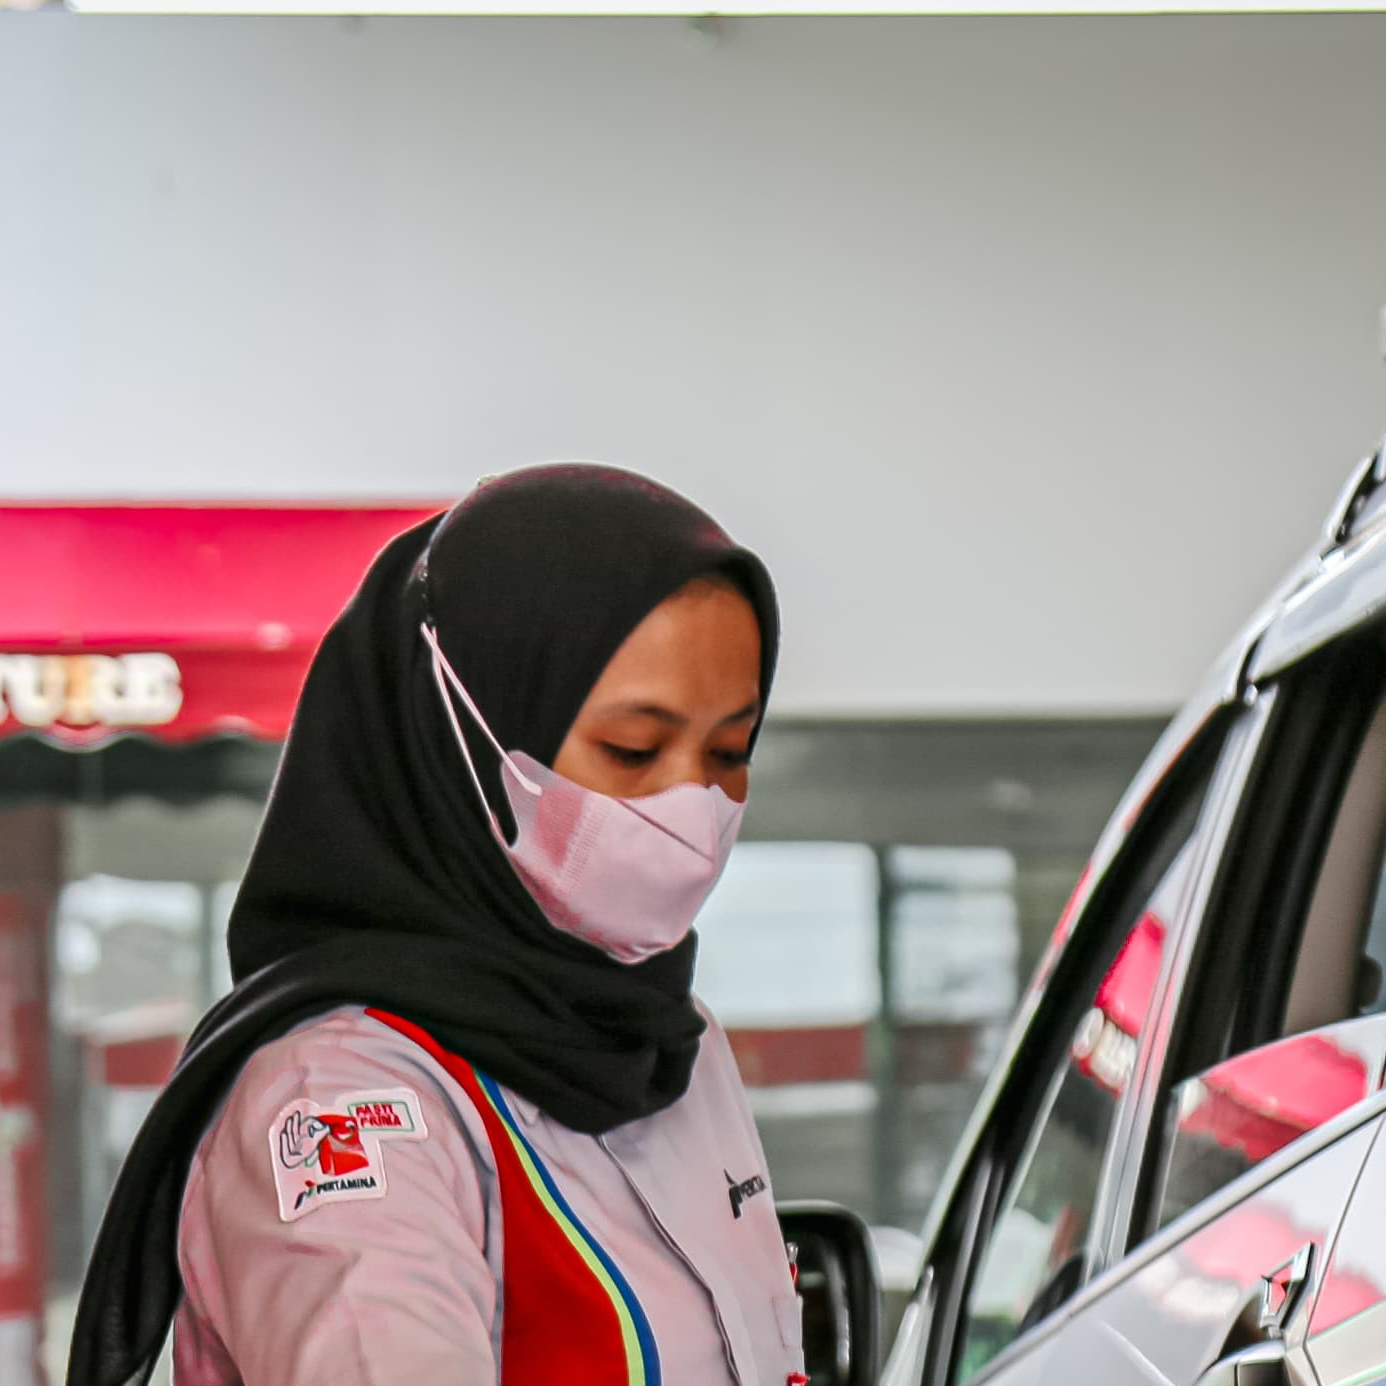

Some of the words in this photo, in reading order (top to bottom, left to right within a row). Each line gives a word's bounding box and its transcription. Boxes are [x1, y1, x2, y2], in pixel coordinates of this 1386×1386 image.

[356, 1104, 393, 1116] PASTI
[360, 1113, 402, 1128] PRIMA
[316, 1176, 377, 1194] PERTAMINA
